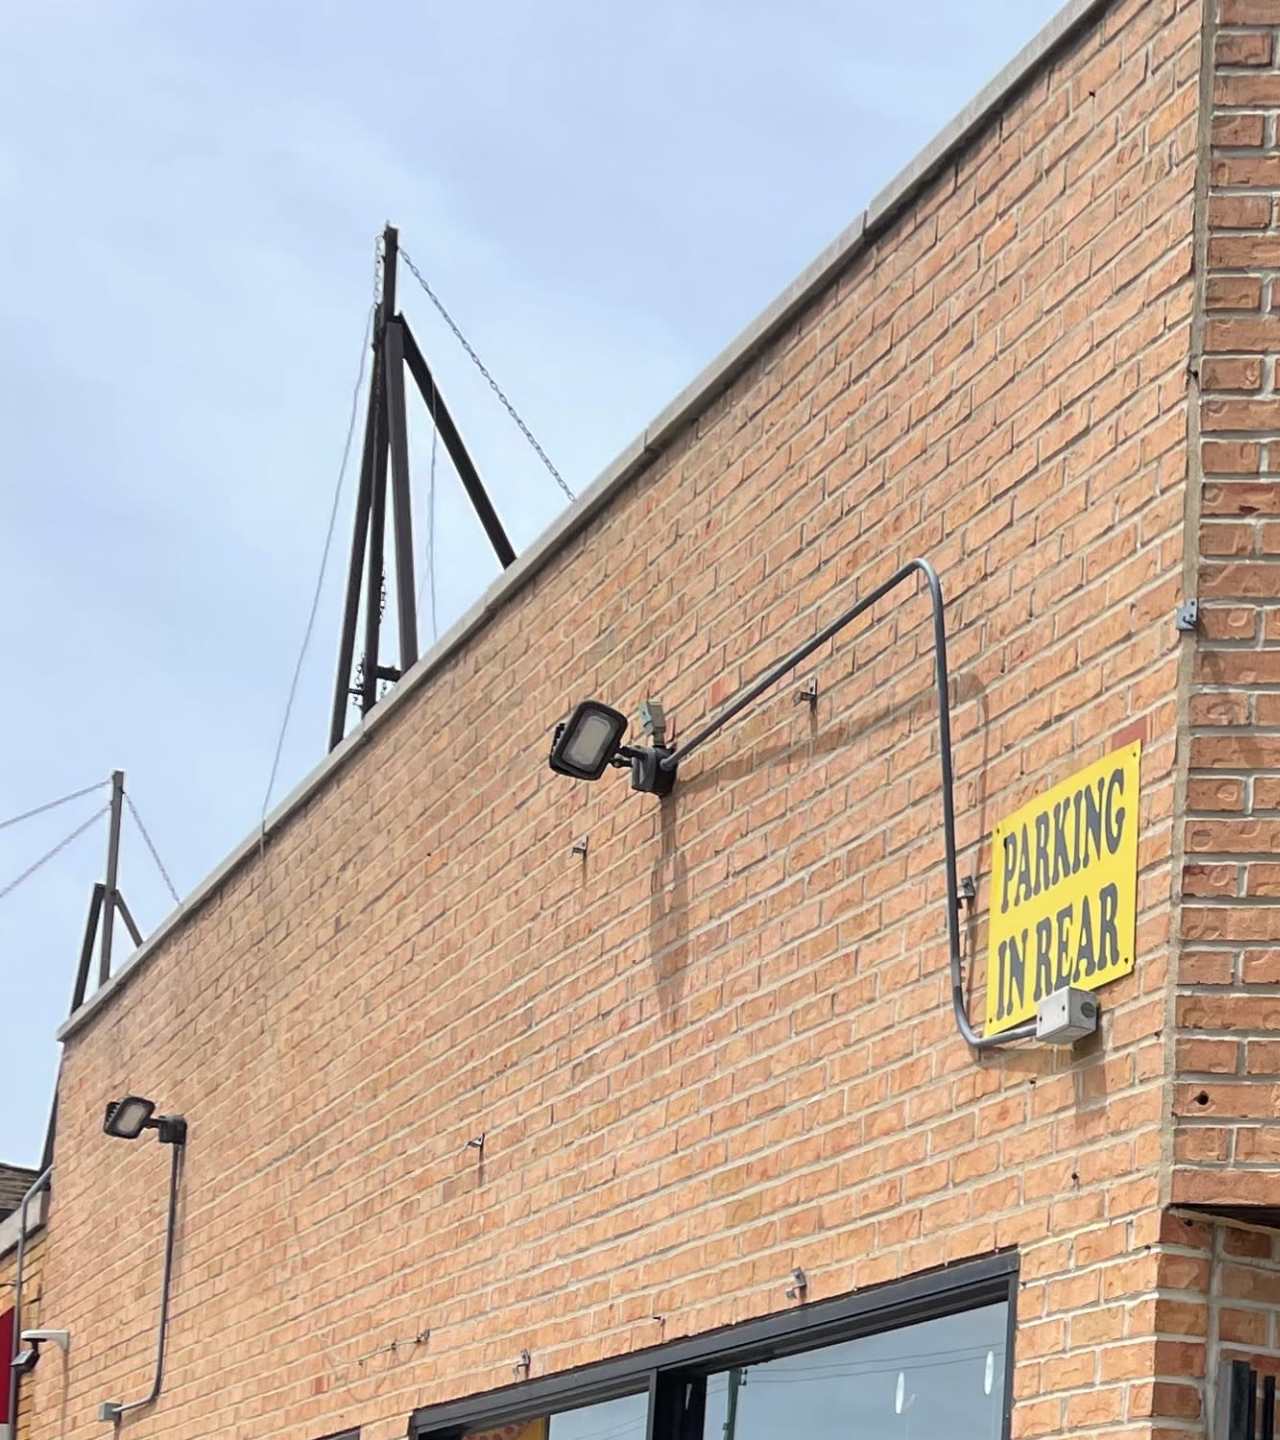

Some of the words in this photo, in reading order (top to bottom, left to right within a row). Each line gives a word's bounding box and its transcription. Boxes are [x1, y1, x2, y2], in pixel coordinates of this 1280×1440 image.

[1001, 769, 1125, 914] PARKING
[996, 928, 1028, 1021] IN
[1033, 882, 1119, 1001] REAR
